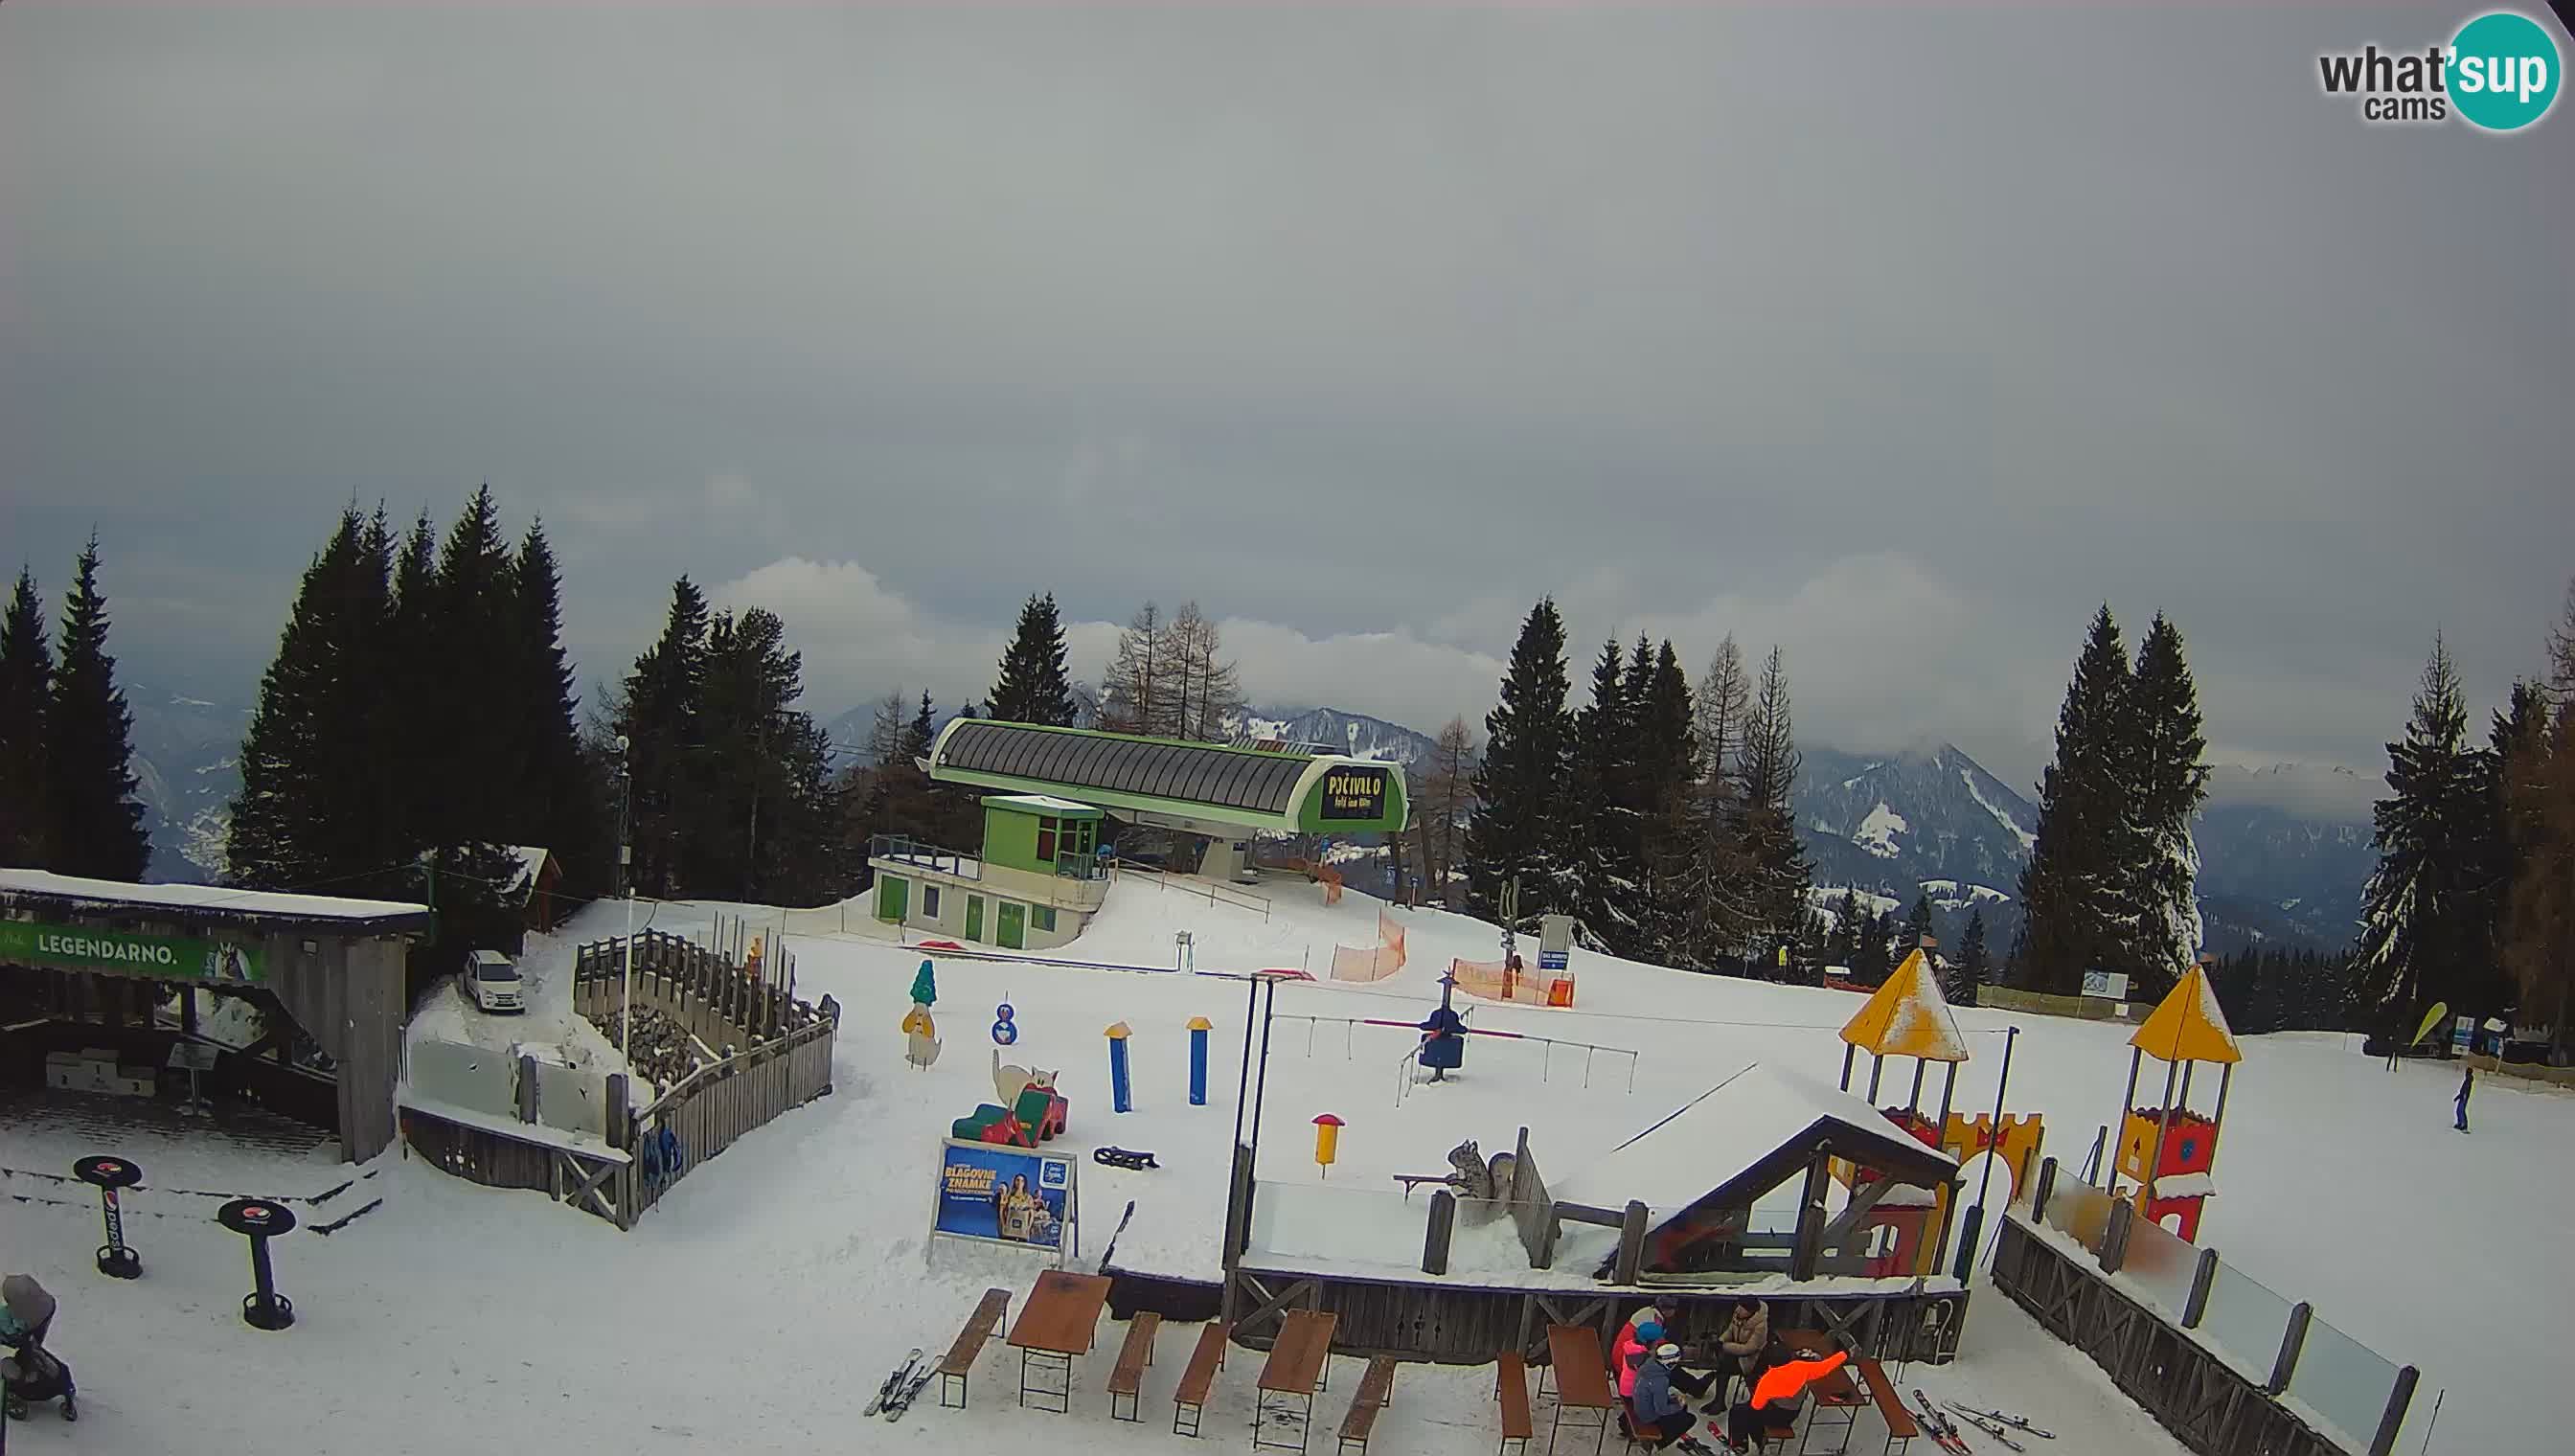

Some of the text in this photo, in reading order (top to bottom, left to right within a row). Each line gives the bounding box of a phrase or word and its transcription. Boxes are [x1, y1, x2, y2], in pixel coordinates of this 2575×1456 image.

[38, 934, 178, 966] LEGENDARNO.
[948, 1177, 992, 1190] ZNAMKE
[106, 1211, 124, 1252] pepsi
